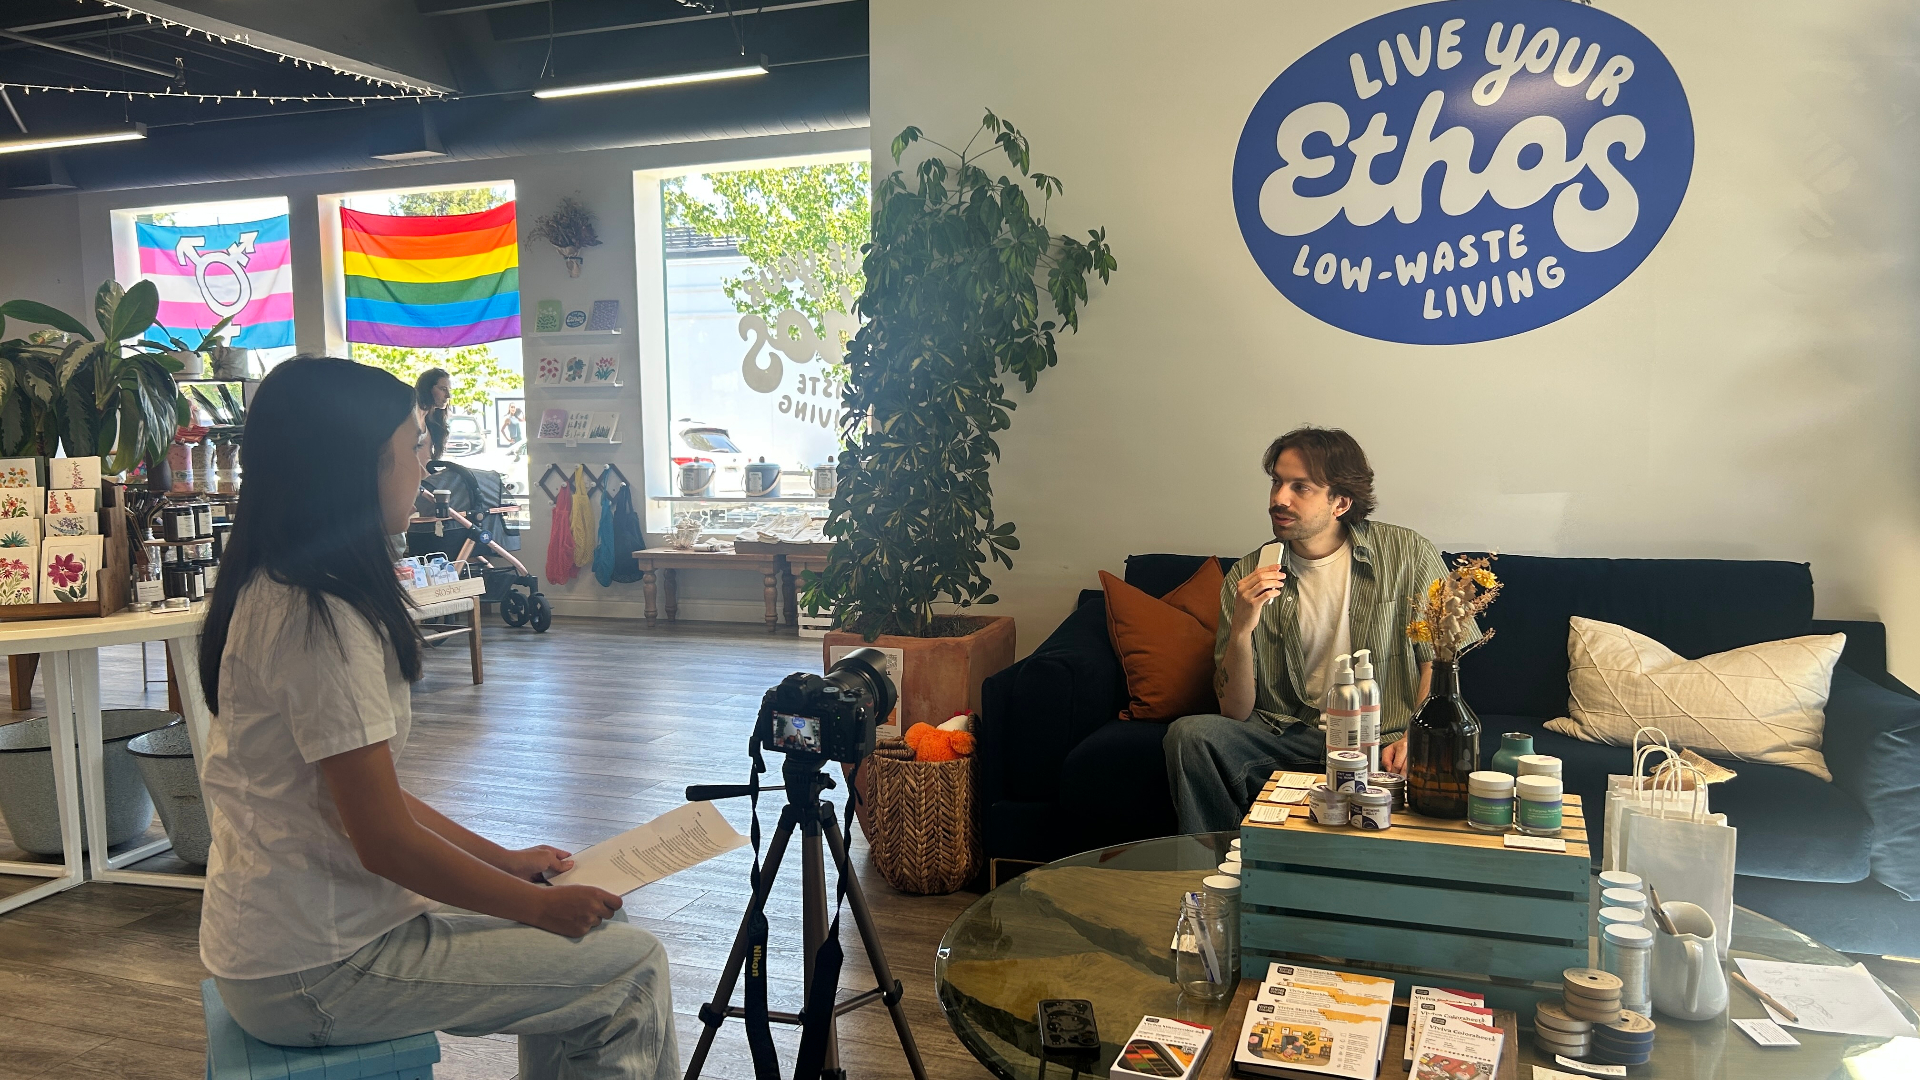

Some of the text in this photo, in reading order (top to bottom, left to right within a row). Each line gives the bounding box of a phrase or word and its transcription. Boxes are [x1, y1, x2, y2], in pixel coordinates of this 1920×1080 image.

[1349, 18, 1466, 100] LIVE
[1259, 90, 1646, 252] Ethos
[1293, 223, 1528, 292] LOW-WASTE
[1423, 256, 1566, 320] LIVING
[435, 585, 462, 597] stasher
[752, 945, 762, 977] Nikon
